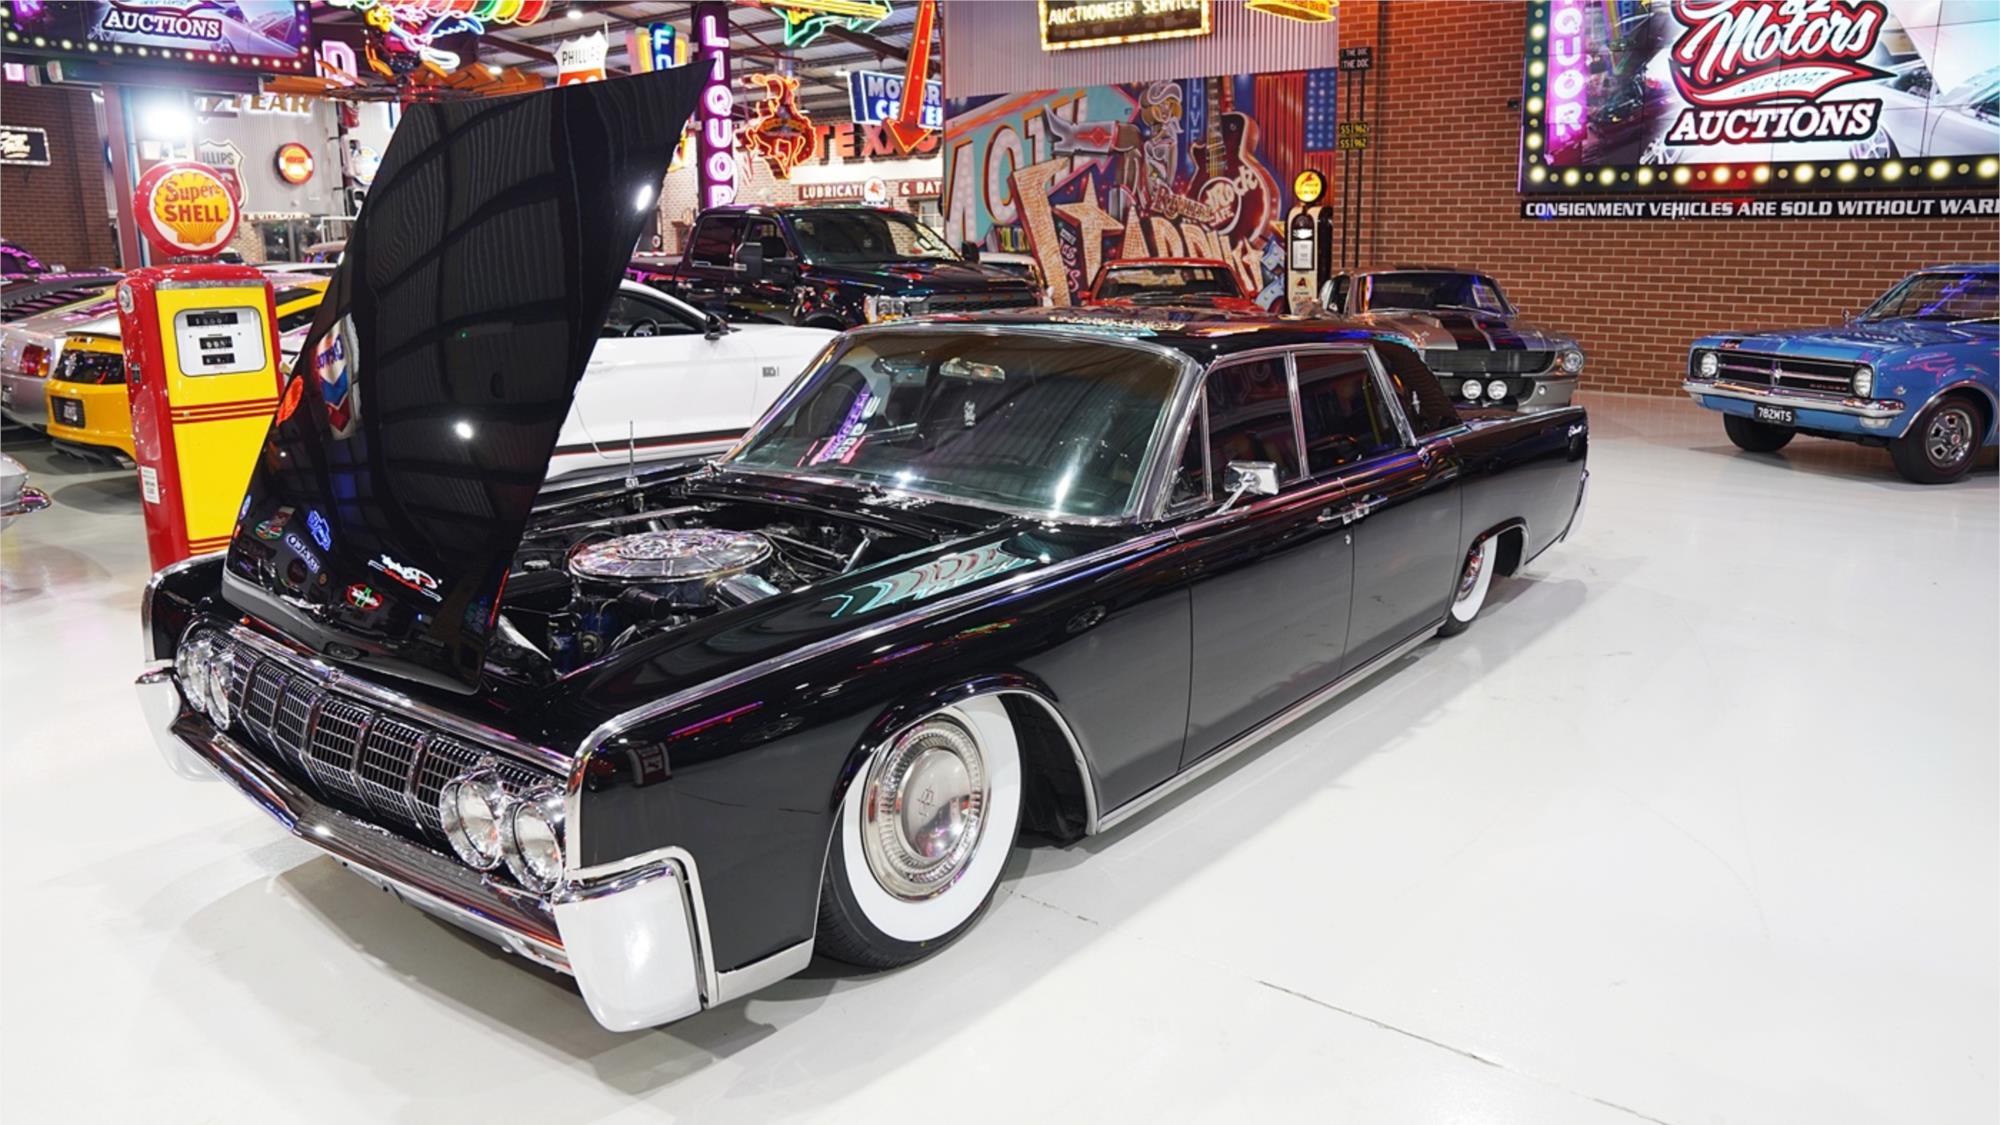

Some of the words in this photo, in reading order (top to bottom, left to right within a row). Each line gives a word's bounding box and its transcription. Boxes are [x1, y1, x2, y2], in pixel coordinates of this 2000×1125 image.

[104, 10, 221, 39] AUCTIONS
[1049, 2, 1136, 25] AUCTIONEER
[1680, 4, 1878, 84] Motors
[1669, 102, 1877, 142] AUCTIONS
[163, 205, 224, 222] SHELL
[1525, 202, 1645, 216] CONSIGNMENT
[1649, 202, 1733, 217] VEHICLES
[1737, 202, 1777, 216] ARE
[1781, 201, 1832, 216] SOLD
[1838, 200, 1935, 215] WITHOUT
[1757, 406, 1793, 422] 782MTS
